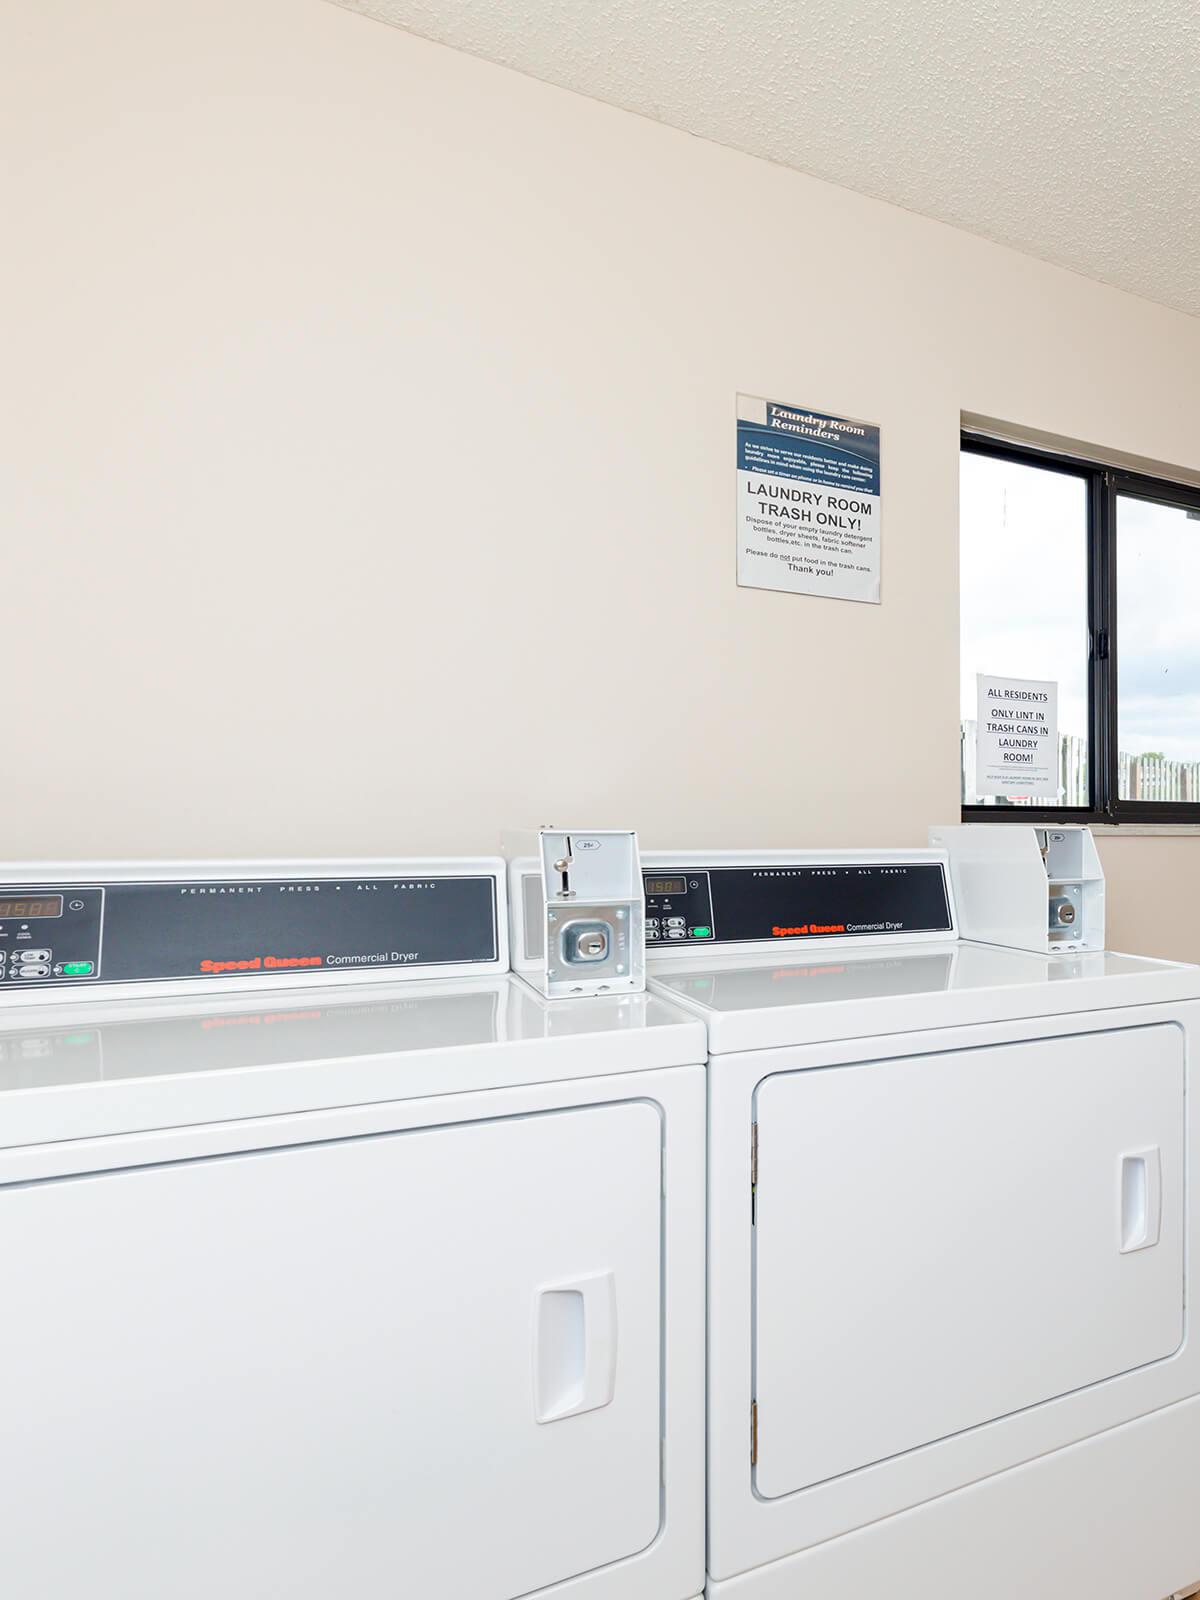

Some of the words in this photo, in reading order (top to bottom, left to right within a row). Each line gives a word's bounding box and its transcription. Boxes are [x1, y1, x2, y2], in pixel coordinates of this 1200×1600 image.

[771, 407, 826, 428] Laundry
[830, 420, 865, 436] Room
[771, 418, 840, 441] Reminders
[747, 481, 822, 506] LAUNDRY
[828, 496, 872, 515] ROOM
[758, 502, 811, 522] TRASH
[816, 513, 861, 531] ONLY!
[746, 516, 773, 526] Dispose
[783, 522, 797, 530] your
[798, 525, 818, 534] empty
[819, 528, 842, 538] laundry
[844, 532, 872, 543] detergent
[779, 530, 796, 538] dryer
[822, 536, 839, 545] fabric
[841, 539, 866, 549] softener
[823, 544, 839, 552] trash
[746, 548, 768, 557] Please
[780, 554, 791, 562] not
[792, 555, 803, 563] put
[804, 557, 819, 565] food
[839, 562, 855, 570] trash
[787, 563, 813, 574] Thank
[816, 568, 834, 577] you!
[988, 688, 1002, 698] ALL
[1004, 690, 1048, 701] RESIDENTS
[991, 709, 1014, 718] ONLY
[1016, 711, 1033, 719] LINT
[1036, 712, 1044, 720] IN
[987, 723, 1014, 733] TRASH
[1017, 725, 1038, 734] CANS
[1040, 727, 1048, 735] IN
[998, 739, 1038, 748] LAUNDRY
[1003, 753, 1033, 762] ROOM!
[772, 926, 808, 936] Speed
[810, 924, 845, 933] Queen
[846, 922, 885, 931] Commercial
[886, 921, 903, 930] Dryer
[200, 957, 260, 973] Speed
[264, 955, 322, 968] Queen
[326, 952, 389, 965] Commercial
[391, 951, 418, 963] Dryer
